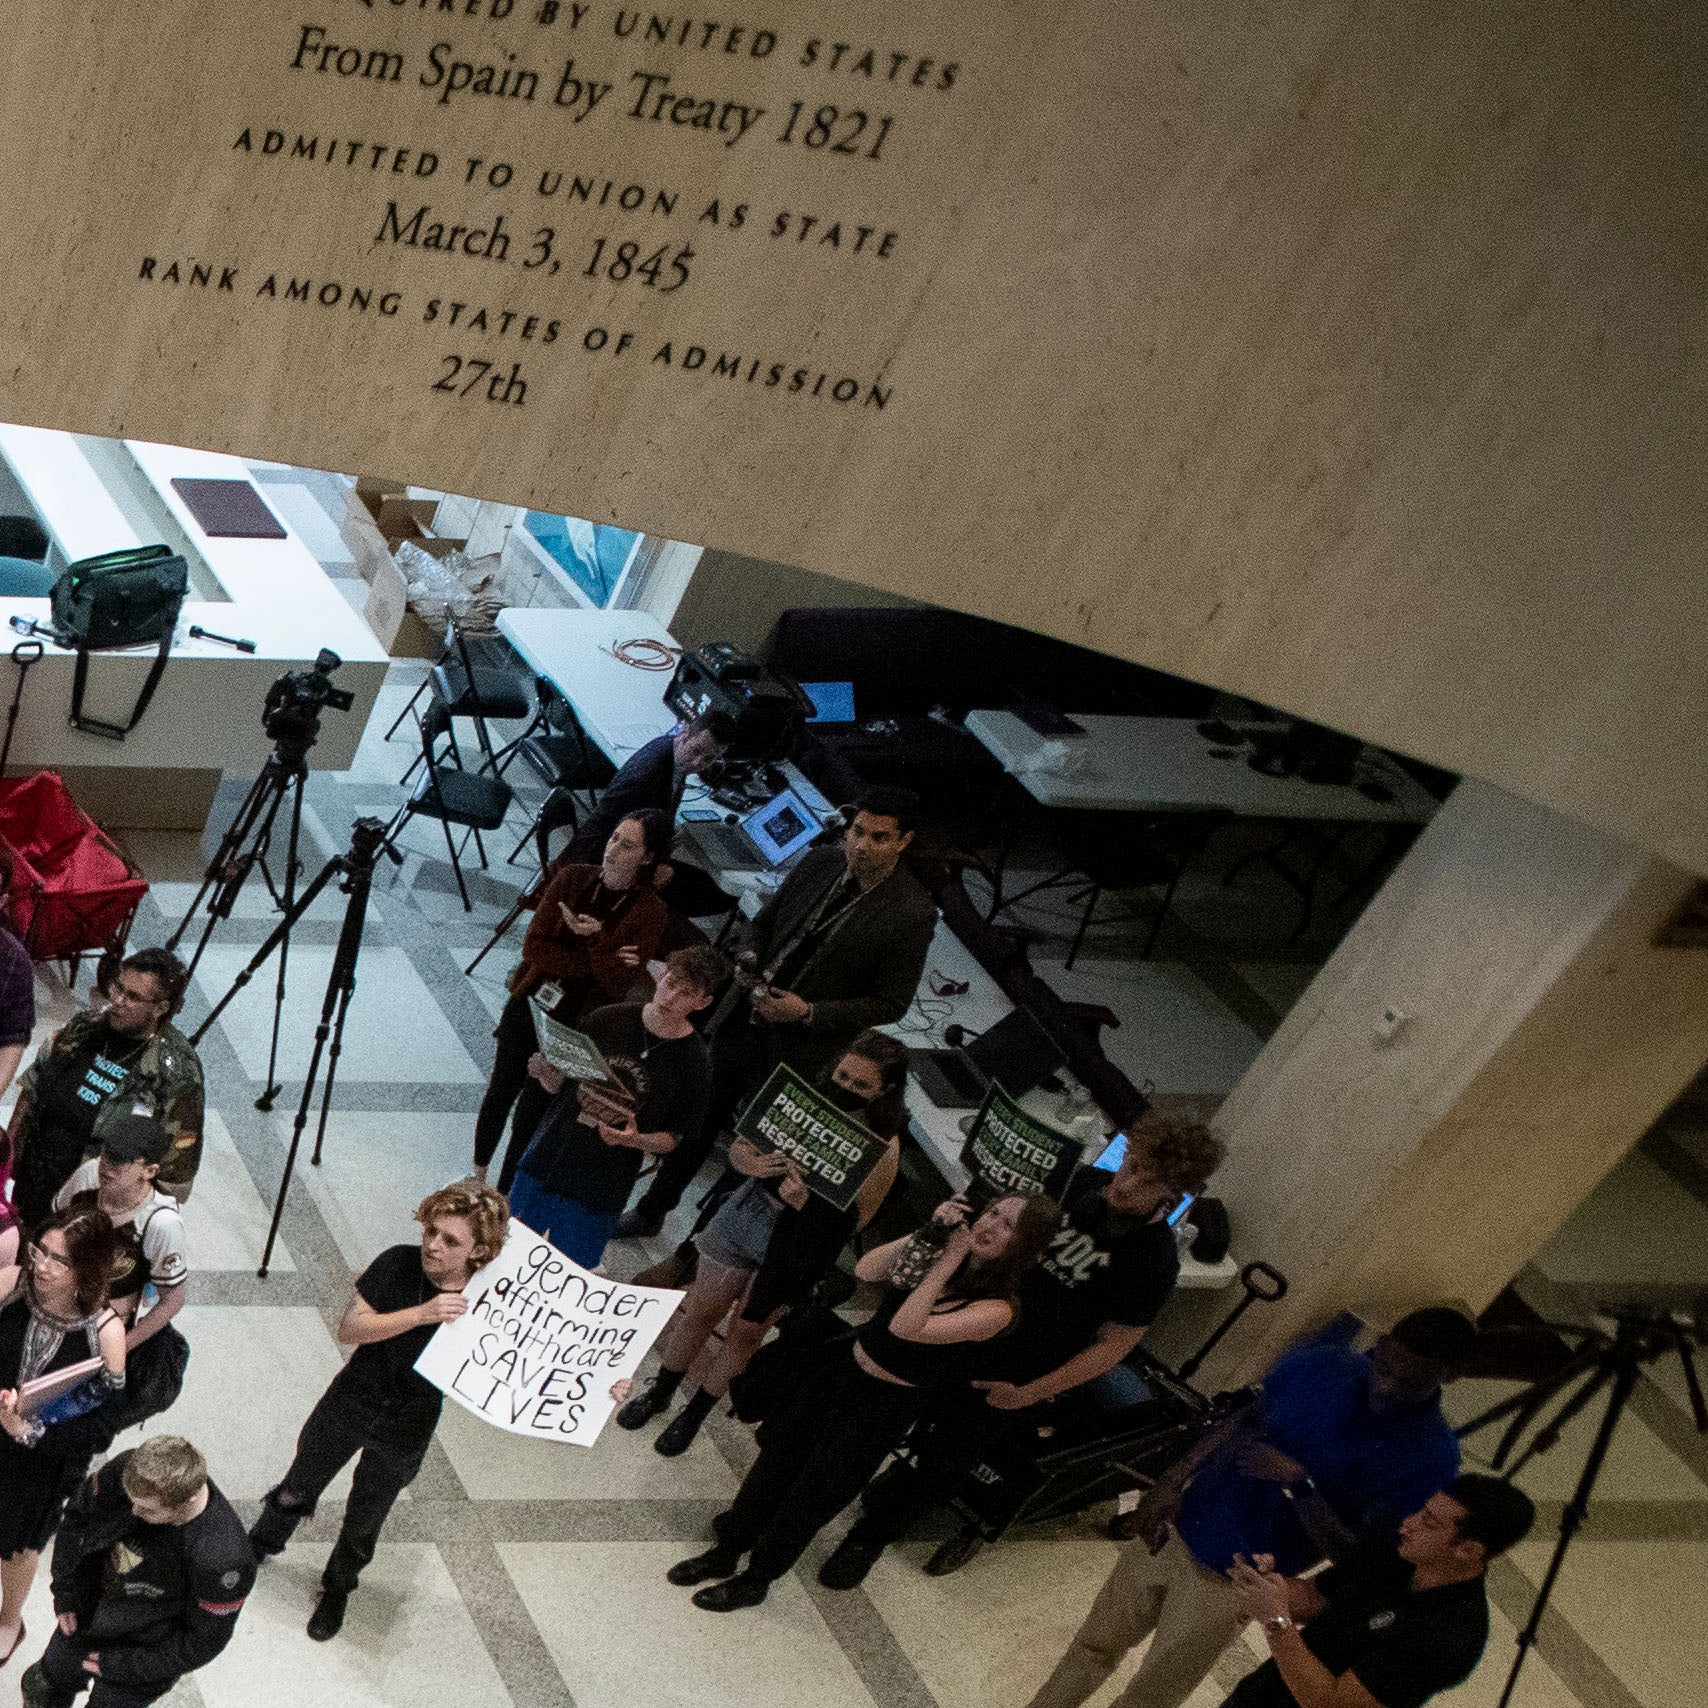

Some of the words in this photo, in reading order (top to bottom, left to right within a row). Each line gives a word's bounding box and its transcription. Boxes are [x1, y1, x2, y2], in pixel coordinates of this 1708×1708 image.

[538, 0, 588, 28] BY
[614, 11, 776, 60] UNITED
[801, 39, 961, 91] STATES
[290, 25, 403, 84] From
[418, 44, 538, 103] Spain
[553, 58, 611, 123] by
[625, 72, 766, 148] Treaty
[784, 101, 897, 161] 1821
[232, 127, 440, 178] ADMITTED
[465, 158, 515, 188] TO
[536, 169, 682, 217] UNION
[699, 199, 749, 229] AS
[772, 211, 900, 259] STATE
[375, 201, 512, 266] March
[524, 216, 562, 275] 3,
[582, 234, 696, 293] 1845
[139, 257, 239, 292] RANK
[256, 273, 402, 317] AMONG
[422, 297, 562, 345] STATES
[585, 326, 635, 358] OF
[653, 341, 895, 411] ADMISSION
[432, 353, 530, 405] 27th
[756, 1116, 846, 1186] RESPECTED
[772, 1091, 863, 1164] PROTECTED
[985, 1108, 1058, 1170] PROTECTED
[494, 1276, 639, 1352] affirming
[517, 1244, 659, 1319] gender
[472, 1288, 626, 1368] healthcare
[451, 1358, 586, 1435] LIVES
[472, 1333, 594, 1401] SAVES
